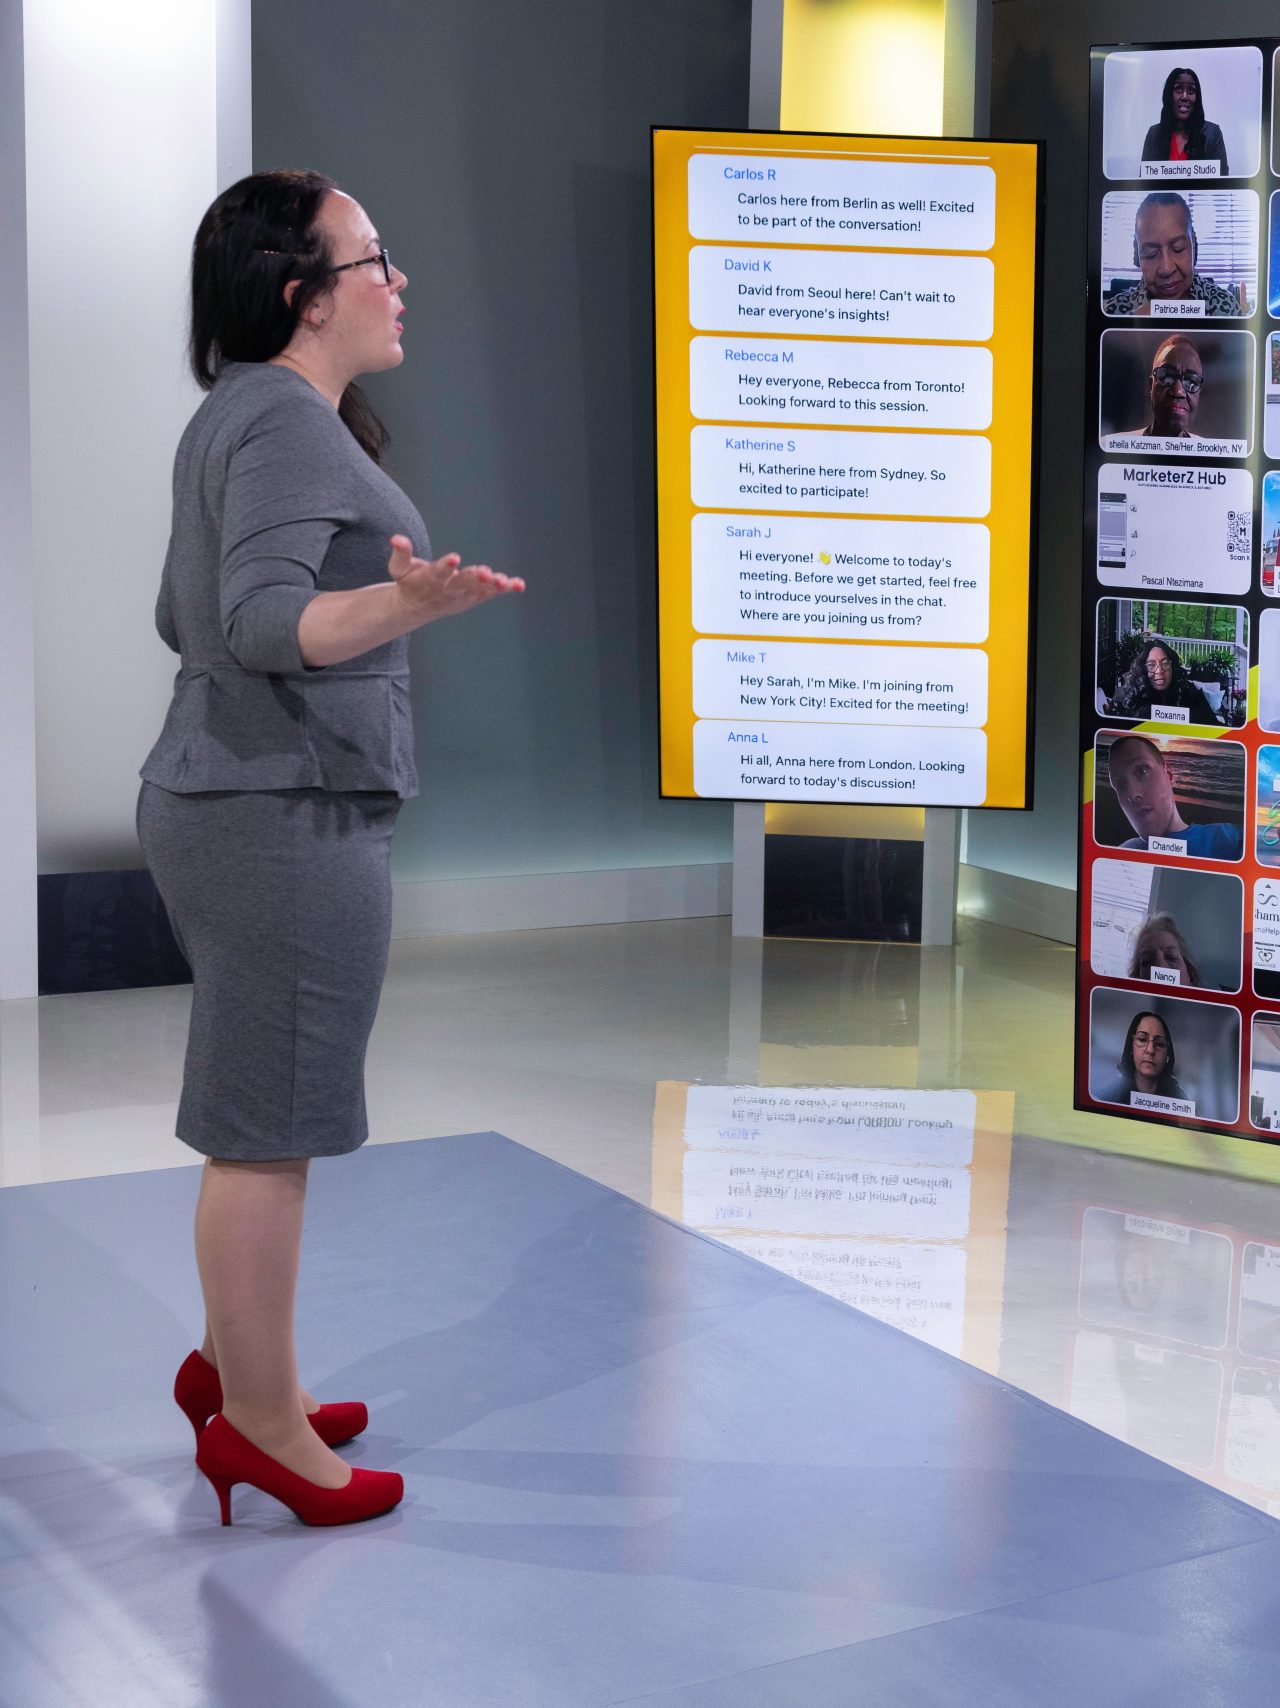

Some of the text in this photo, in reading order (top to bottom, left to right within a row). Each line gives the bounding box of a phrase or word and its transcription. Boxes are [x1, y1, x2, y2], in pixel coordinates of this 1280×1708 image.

[724, 167, 775, 180] Carlos R
[1145, 164, 1216, 176] The Teaching Studio
[738, 192, 973, 212] Carlos here from Berlin as well! Excited
[738, 214, 920, 231] to be part of the conversation!
[1123, 468, 1226, 485] MarketerZ Hub
[726, 525, 770, 538] Sarah J
[739, 550, 951, 569] Hi everyone! Welcome to today's
[739, 570, 976, 588] meeting. Before we get started, feel free
[739, 589, 945, 606] to introduce yourselves in the chat.
[740, 609, 921, 626] Where are you joining us from?
[727, 731, 768, 743] Anna L
[741, 754, 964, 774] Hi all, Anna here from London. Looking
[740, 773, 915, 789] forward to today's discussion!
[1154, 970, 1176, 984] Nancy
